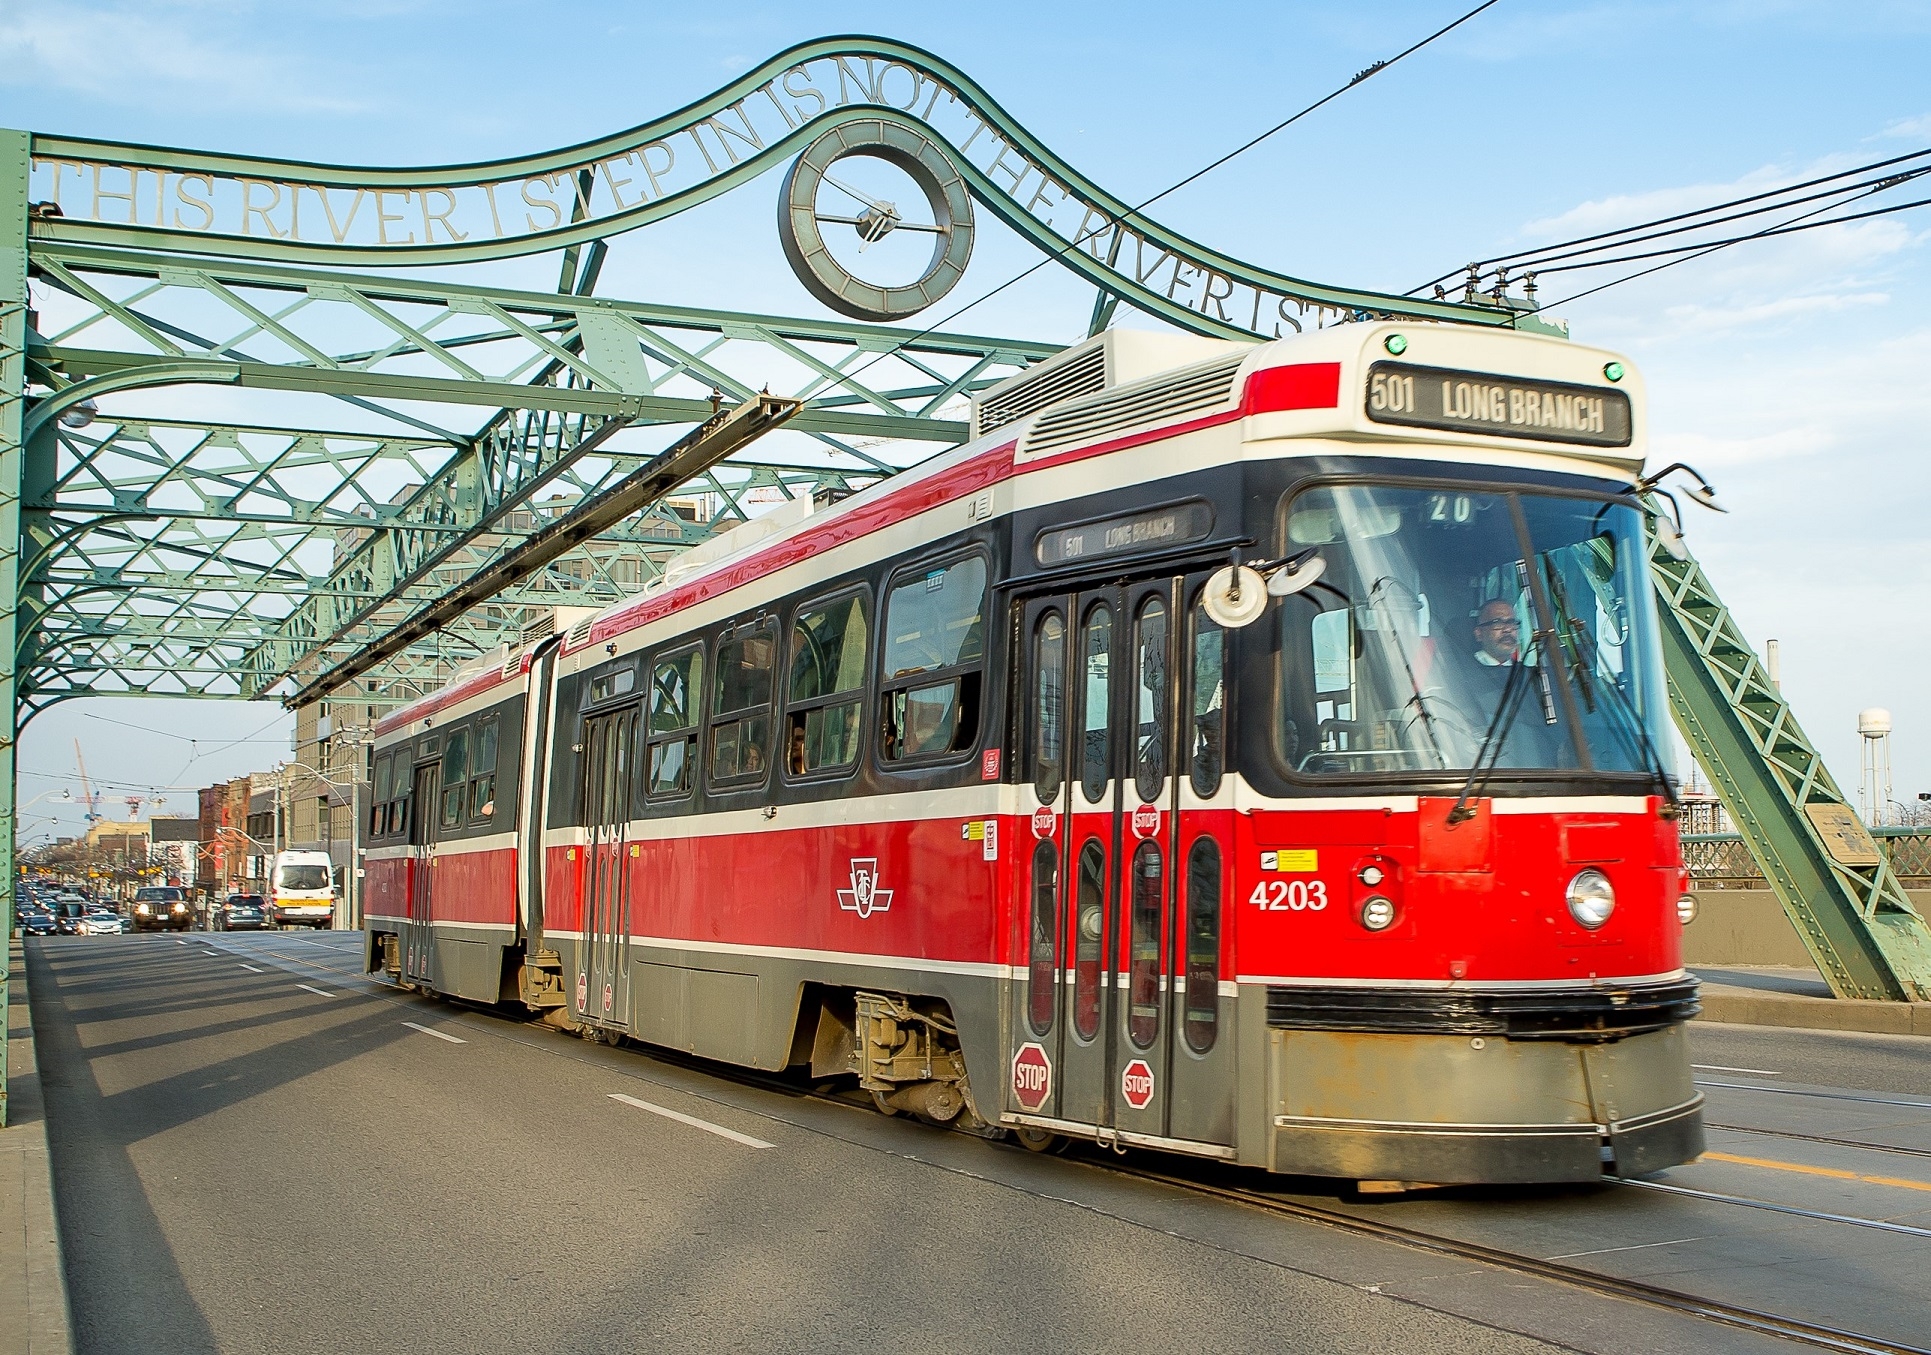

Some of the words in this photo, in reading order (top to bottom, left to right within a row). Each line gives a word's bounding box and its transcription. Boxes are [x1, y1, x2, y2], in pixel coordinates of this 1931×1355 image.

[32, 156, 214, 230] THIS
[234, 177, 469, 244] RIVER
[477, 182, 505, 237] I
[521, 139, 675, 232] STEP
[682, 98, 766, 175] IN
[757, 64, 825, 130] IS
[829, 55, 958, 121] NOT
[960, 105, 1072, 226] THE
[1073, 199, 1234, 322] RIVER
[1370, 373, 1415, 413] 501
[1442, 381, 1507, 422] LONG
[1509, 388, 1605, 434] BRANCH
[1065, 536, 1084, 557] 501
[1105, 525, 1133, 549] LONG
[1133, 516, 1176, 542] BRANCH
[1034, 815, 1054, 830] STOP
[1134, 812, 1157, 828] STOP
[1249, 880, 1328, 911] 4203
[1016, 1062, 1047, 1091] STOP
[1125, 1075, 1151, 1094] STOP
